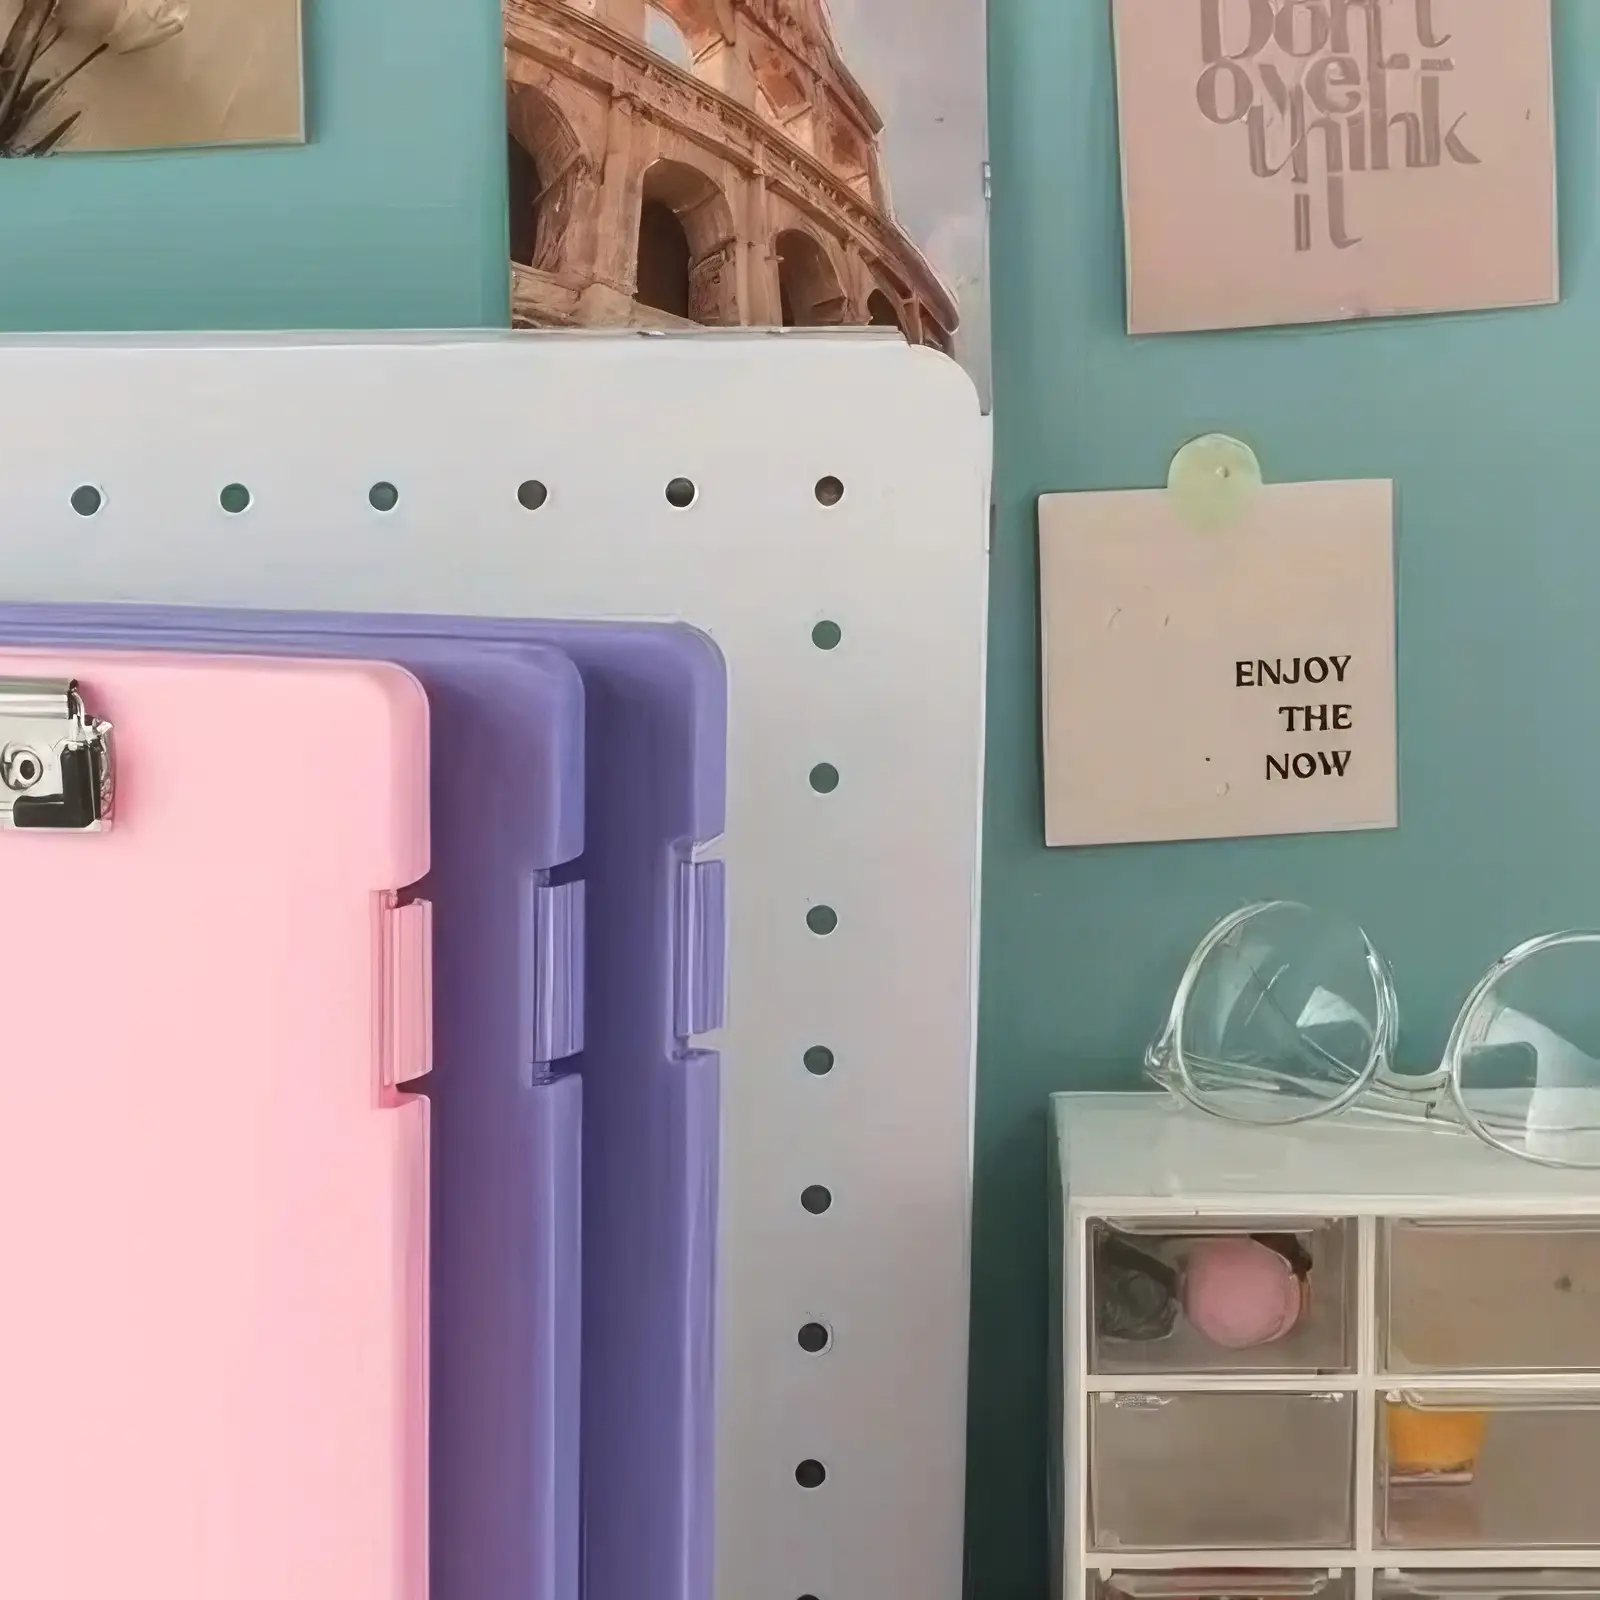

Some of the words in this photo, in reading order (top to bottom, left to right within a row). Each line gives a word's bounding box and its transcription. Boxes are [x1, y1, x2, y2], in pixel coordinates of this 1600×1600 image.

[1200, 0, 1452, 63] Dont
[1294, 175, 1363, 251] it
[1235, 655, 1352, 687] ENJOY
[1278, 704, 1353, 732] THE
[1266, 750, 1352, 780] NOW
